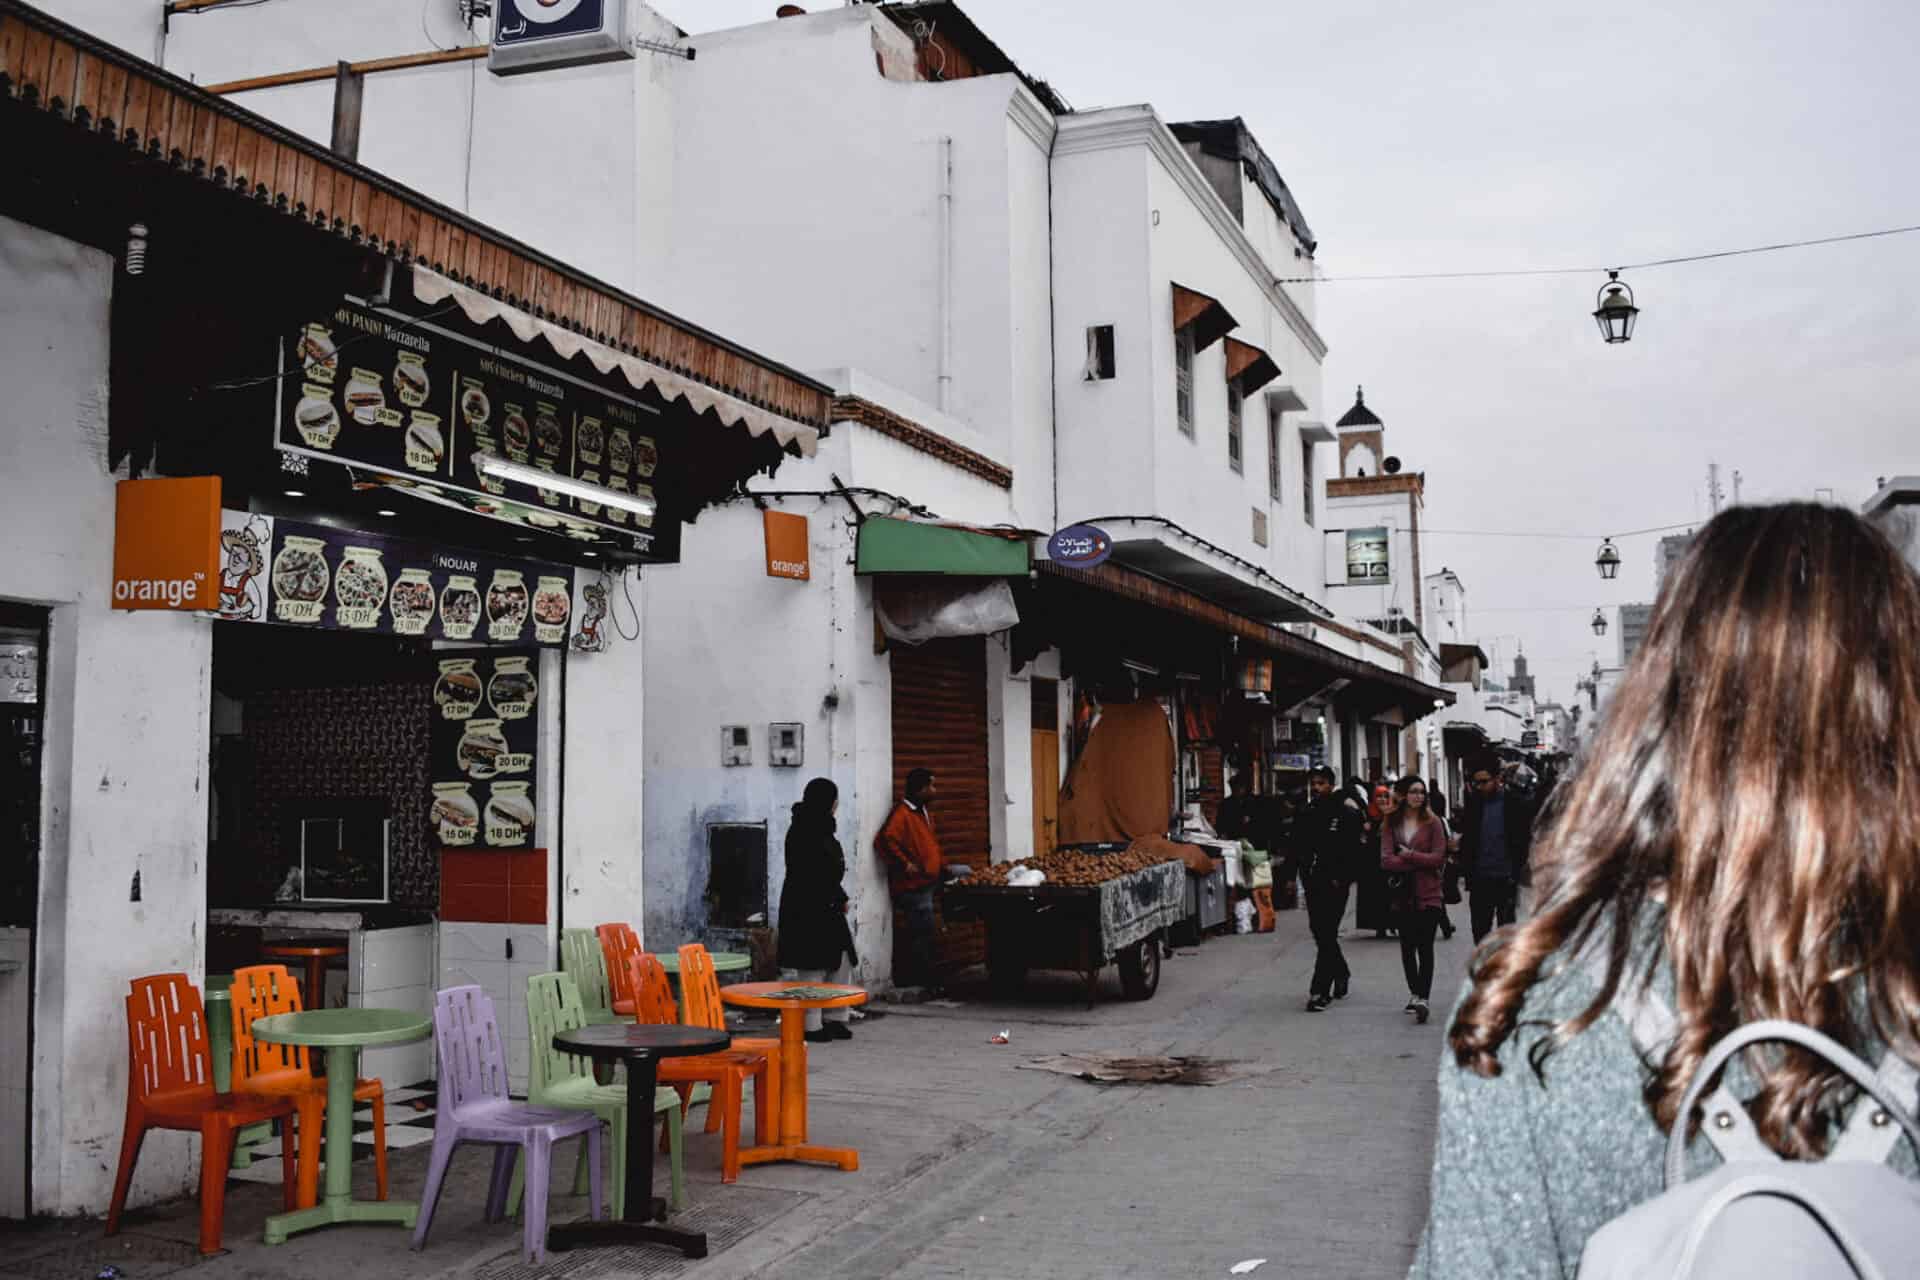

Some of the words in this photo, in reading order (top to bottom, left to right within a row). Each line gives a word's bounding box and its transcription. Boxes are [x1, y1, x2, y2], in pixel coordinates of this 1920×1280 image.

[384, 323, 431, 353] Mozzarella
[308, 432, 317, 442] 17
[318, 434, 330, 444] DH
[409, 452, 420, 462] 18
[420, 454, 434, 466] DH
[771, 560, 804, 577] orange
[115, 579, 197, 607] orange
[279, 603, 290, 615] 15
[294, 603, 315, 617] DH
[339, 610, 350, 620] 15
[351, 610, 371, 622] DH
[446, 706, 456, 714] 17
[457, 705, 469, 714] DH
[512, 704, 525, 713] DH
[499, 756, 510, 767] 20
[512, 756, 526, 767] DH
[458, 829, 471, 838] DH
[491, 828, 504, 838] 18
[505, 828, 521, 838] DH
